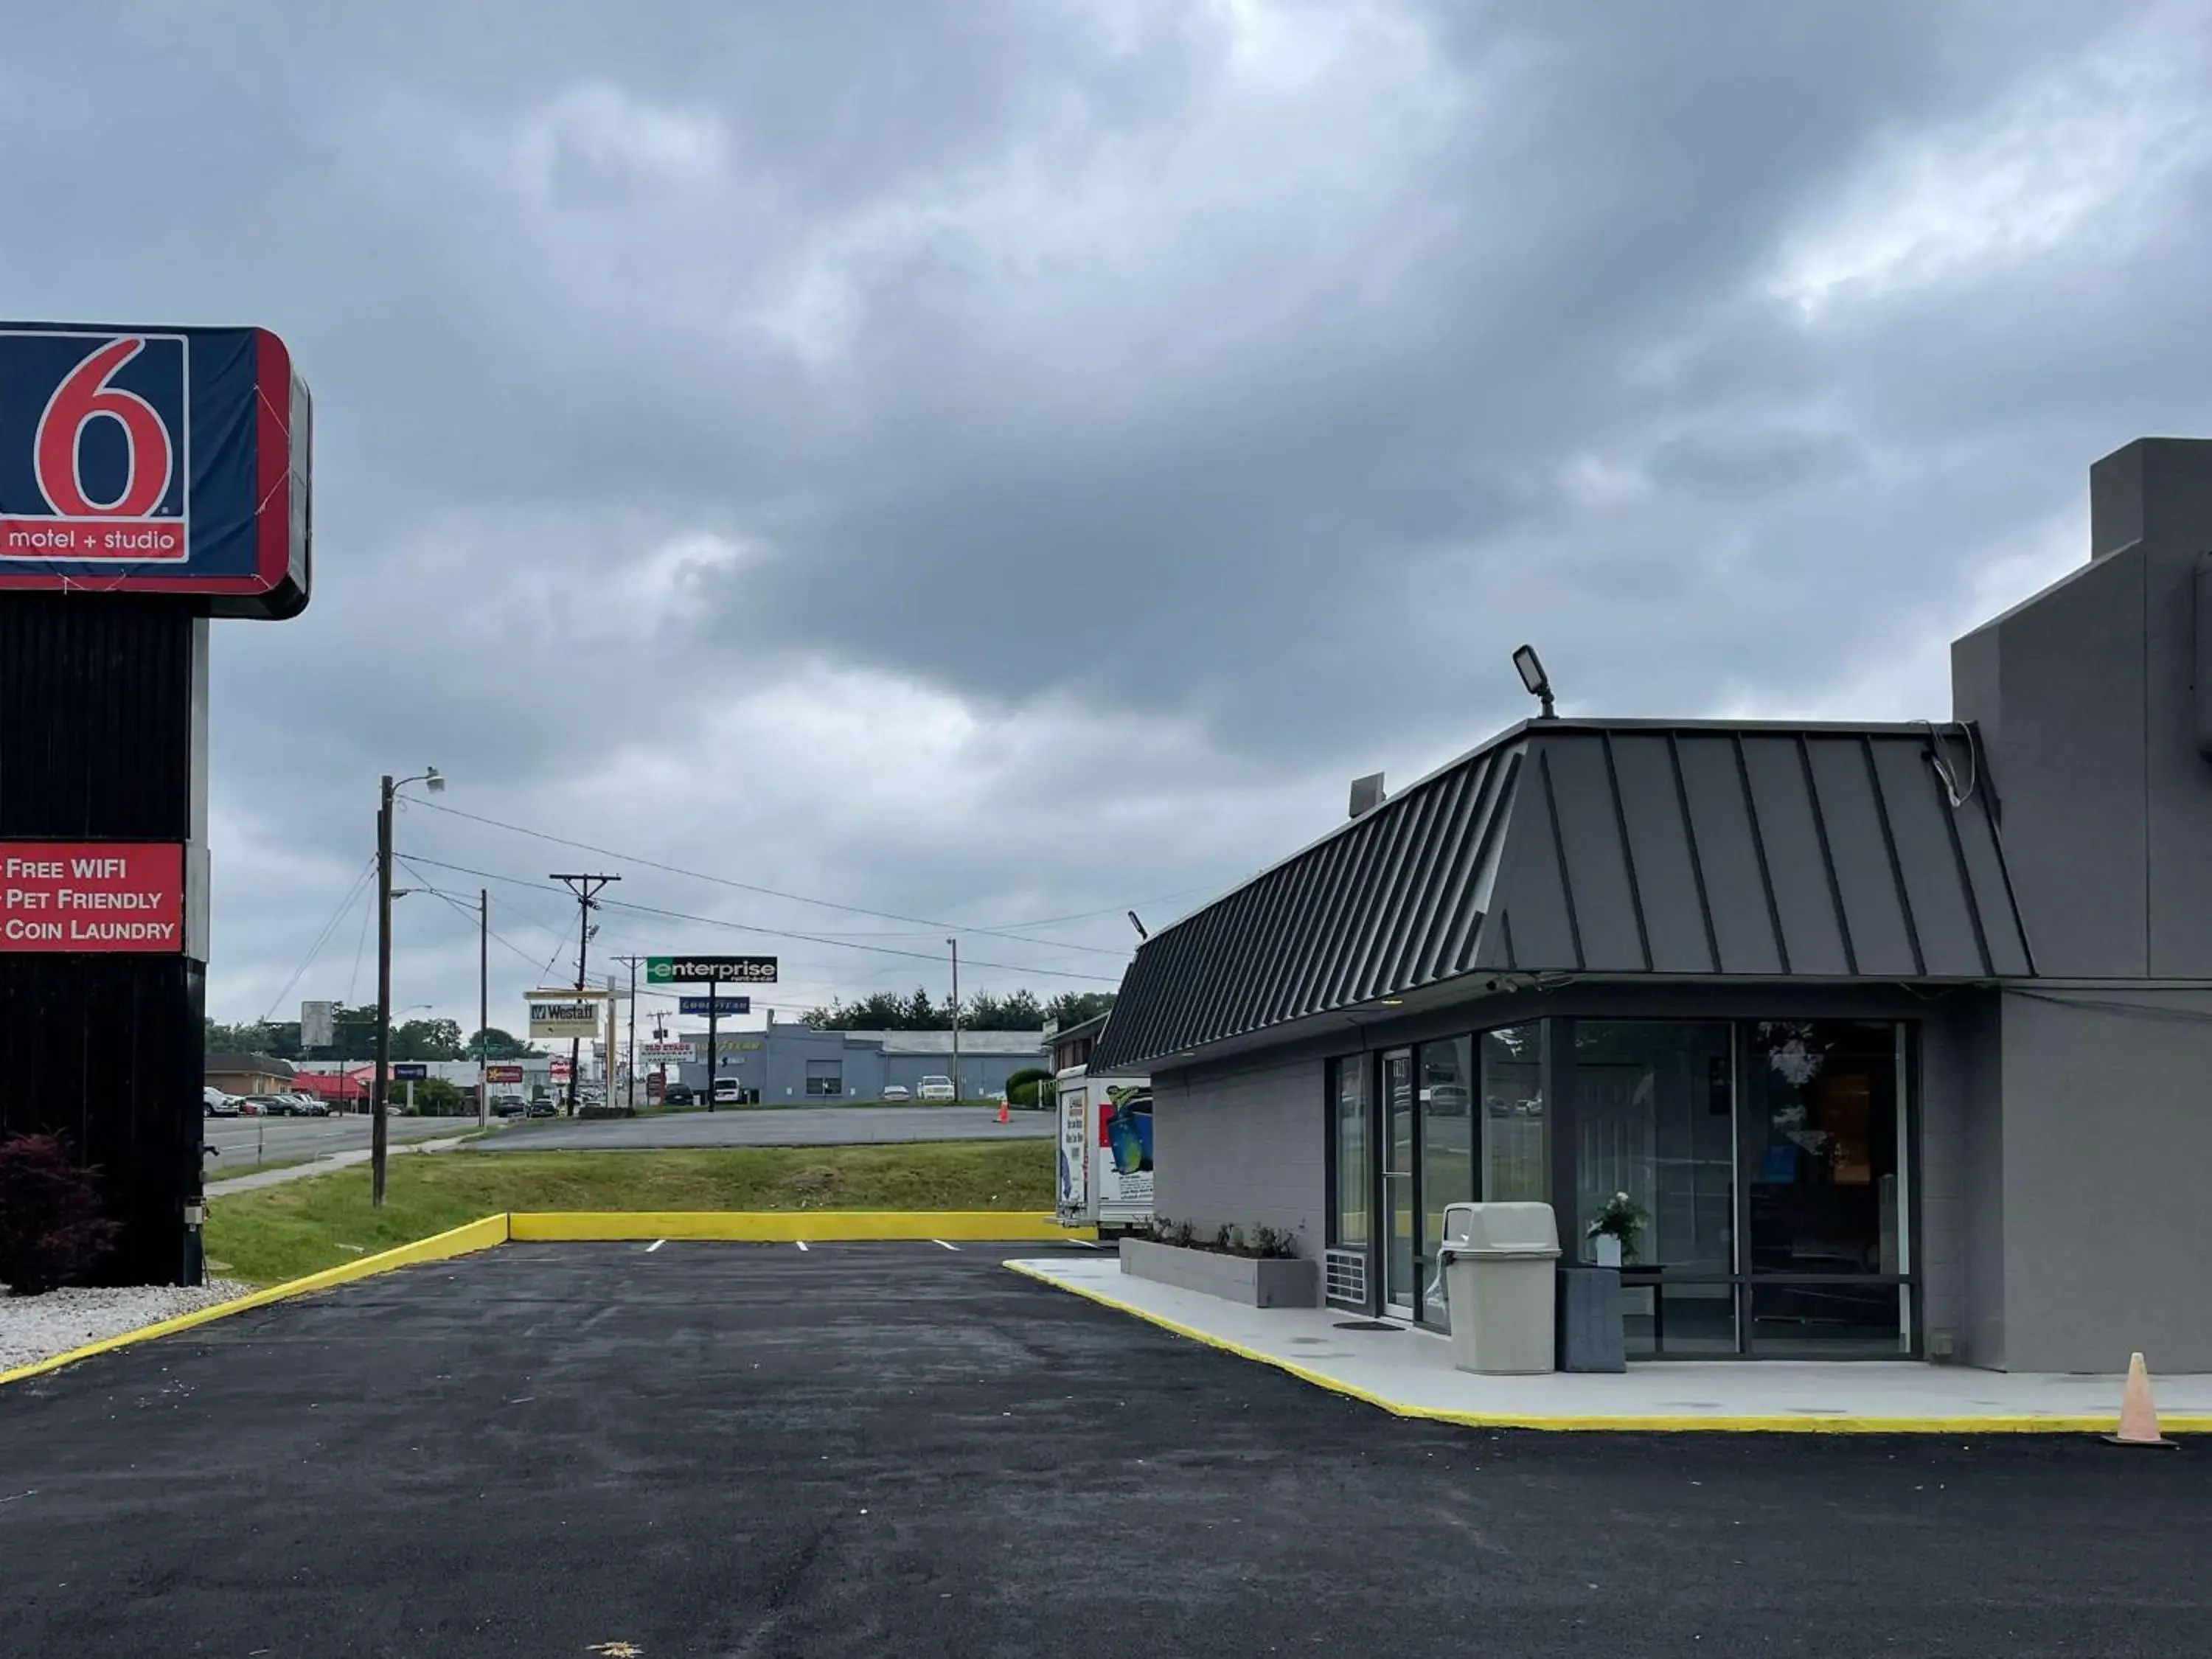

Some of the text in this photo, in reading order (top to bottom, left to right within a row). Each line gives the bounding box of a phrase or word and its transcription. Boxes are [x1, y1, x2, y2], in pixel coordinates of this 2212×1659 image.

[34, 335, 173, 518] 6
[9, 529, 75, 548] motel
[104, 530, 175, 549] studio
[6, 858, 126, 879] FREE WIFI
[6, 888, 162, 909] PET FRIENDLY
[5, 919, 175, 939] COIN LAUNDRY
[653, 961, 776, 980] enterprise
